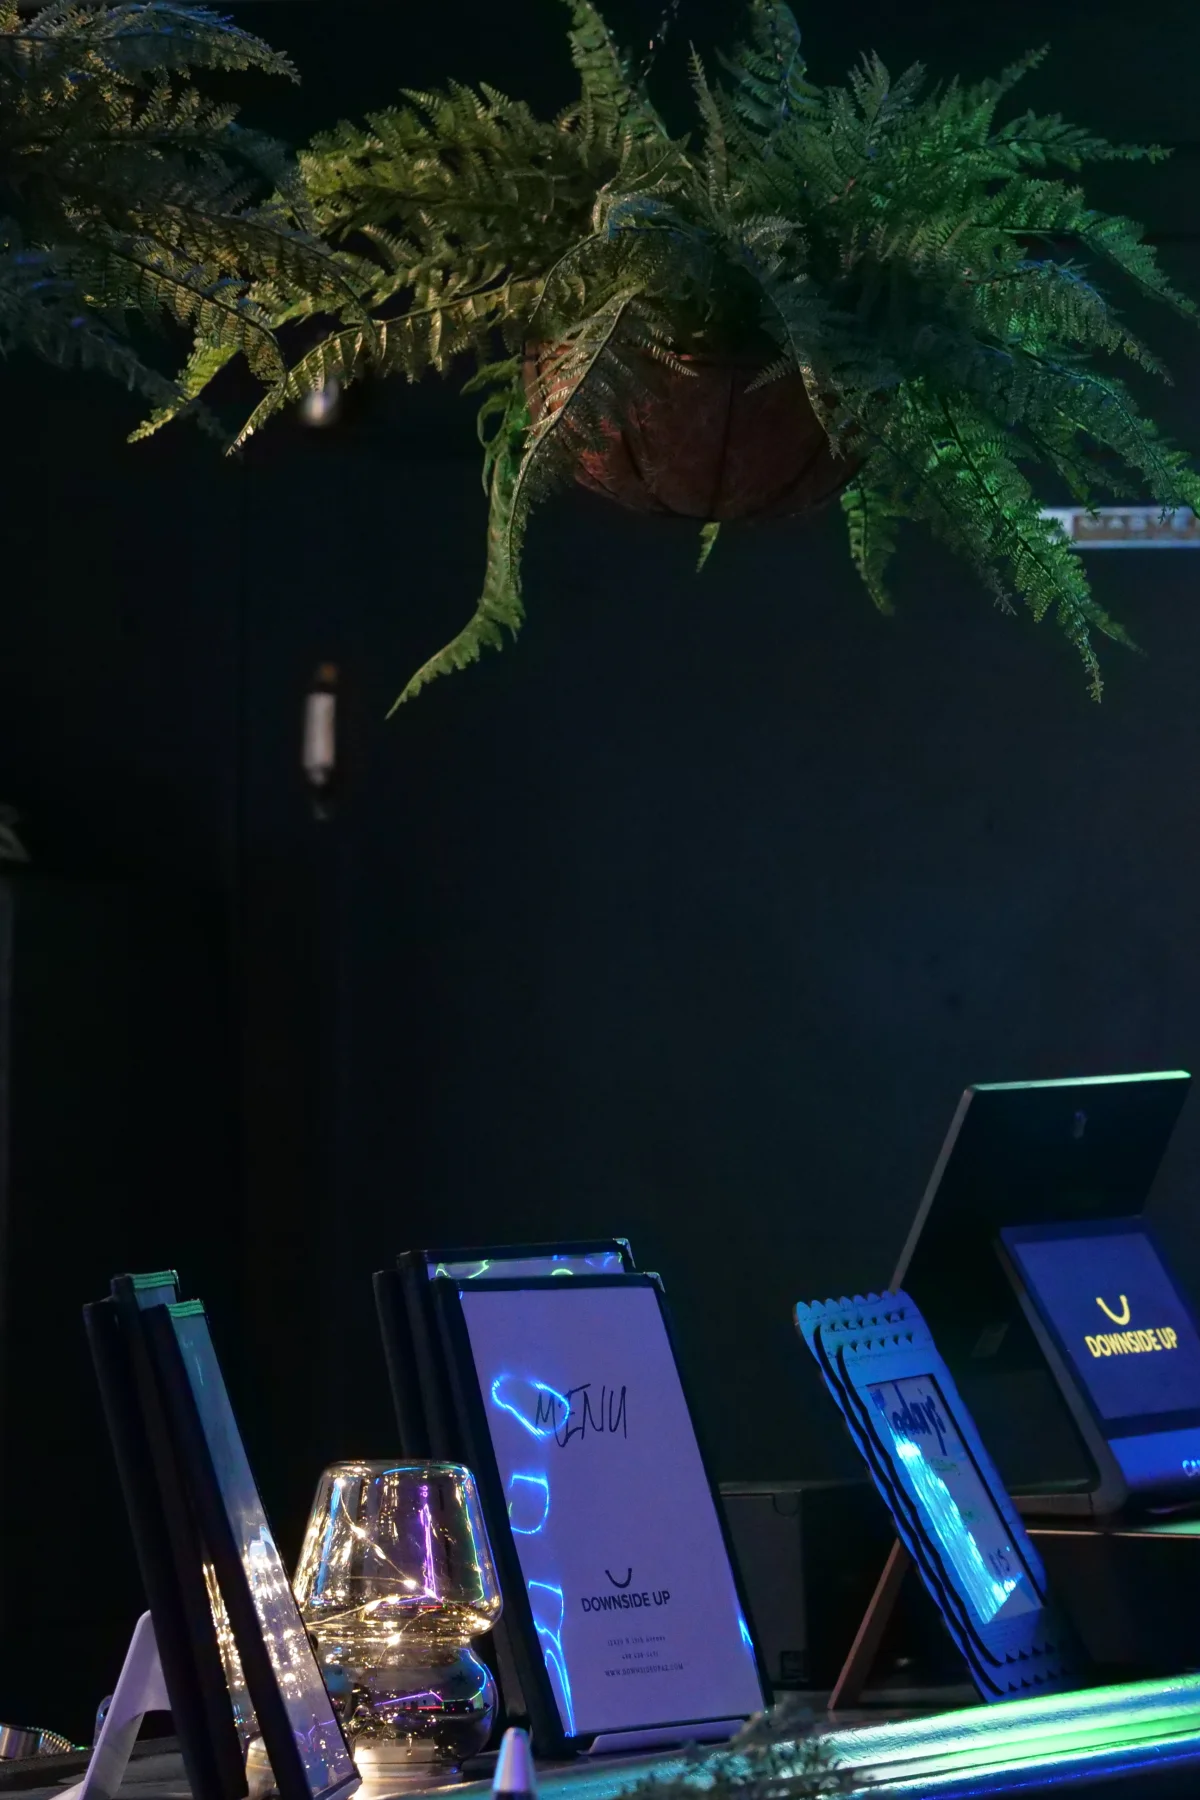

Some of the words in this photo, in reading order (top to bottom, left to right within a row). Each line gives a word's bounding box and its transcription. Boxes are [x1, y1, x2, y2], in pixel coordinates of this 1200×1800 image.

[1084, 1328, 1162, 1359] DOWNSIDE
[1156, 1326, 1178, 1351] UP
[535, 1383, 627, 1448] MENU
[580, 1592, 651, 1613] DOWNSIDE
[652, 1590, 671, 1606] UP
